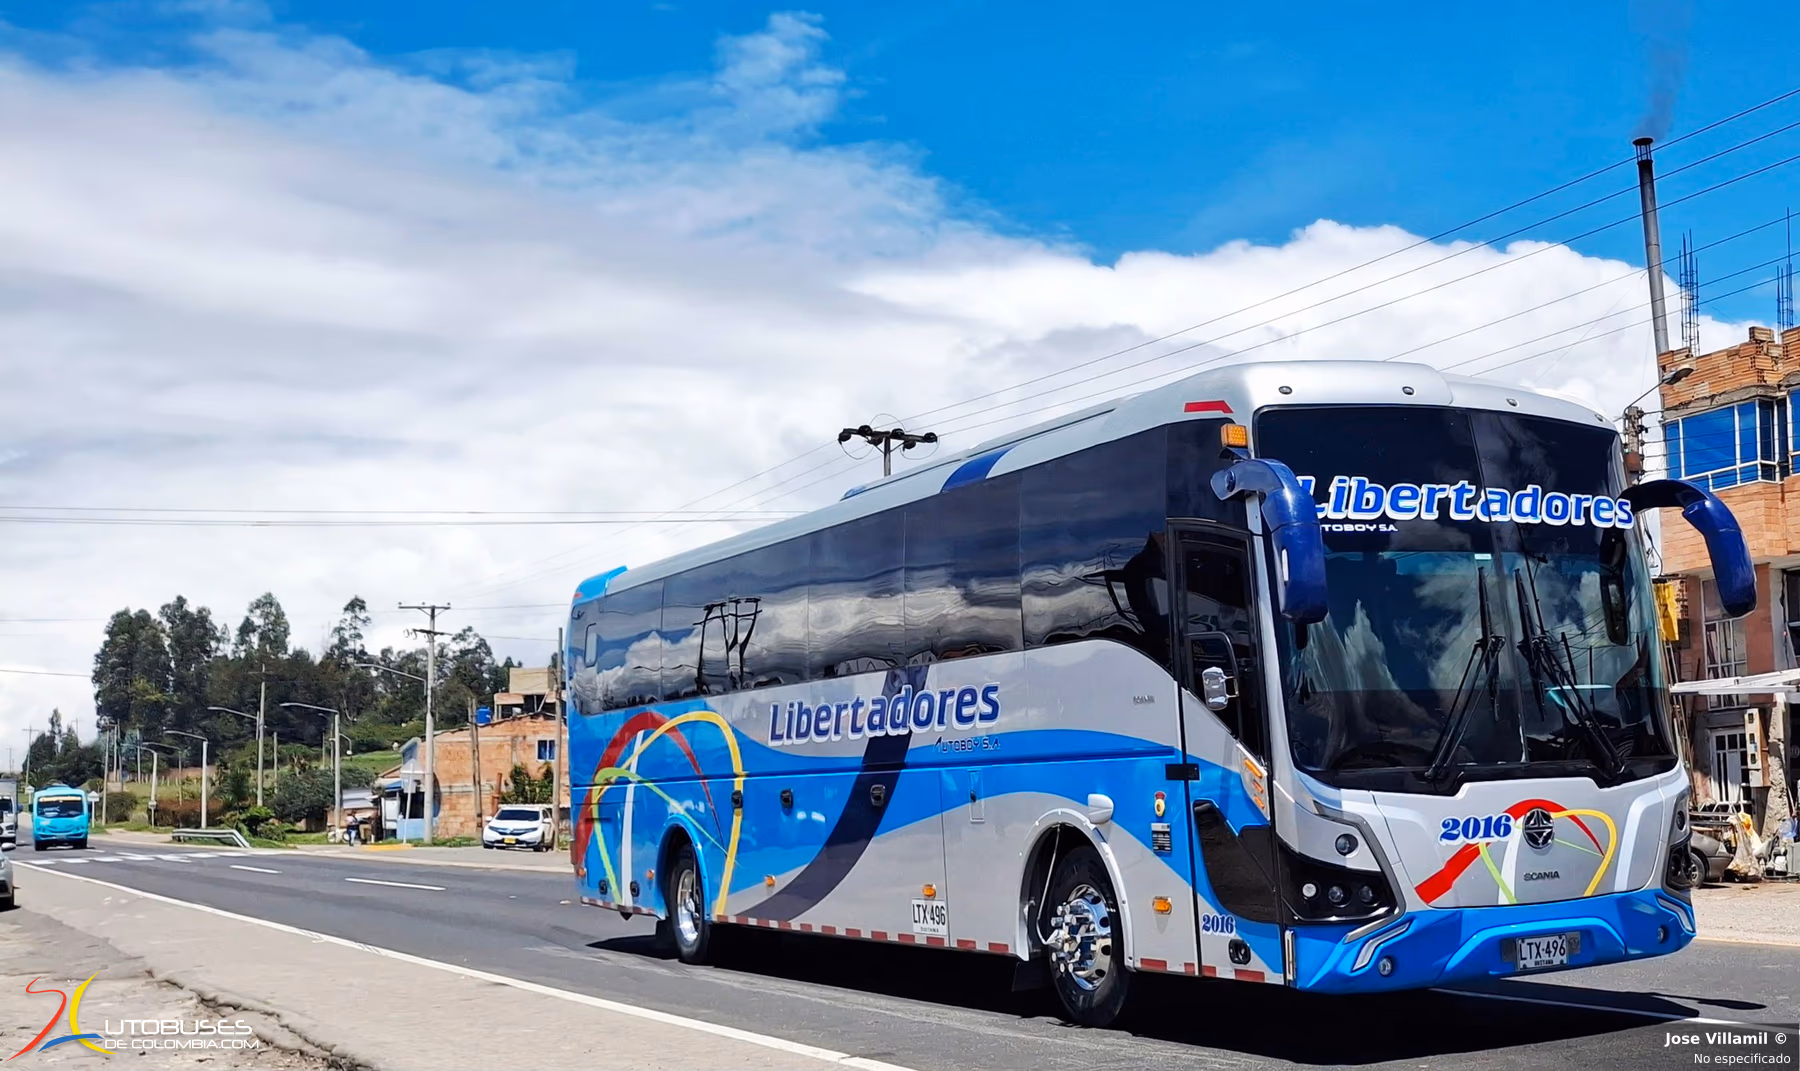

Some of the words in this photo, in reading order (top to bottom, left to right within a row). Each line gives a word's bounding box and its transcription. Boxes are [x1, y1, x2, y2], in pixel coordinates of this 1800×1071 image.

[1321, 523, 1376, 532] TOBOY
[768, 682, 1001, 747] Libertadores
[1439, 813, 1514, 844] 2016
[1523, 870, 1560, 882] SCANIA
[1202, 913, 1235, 935] 2016
